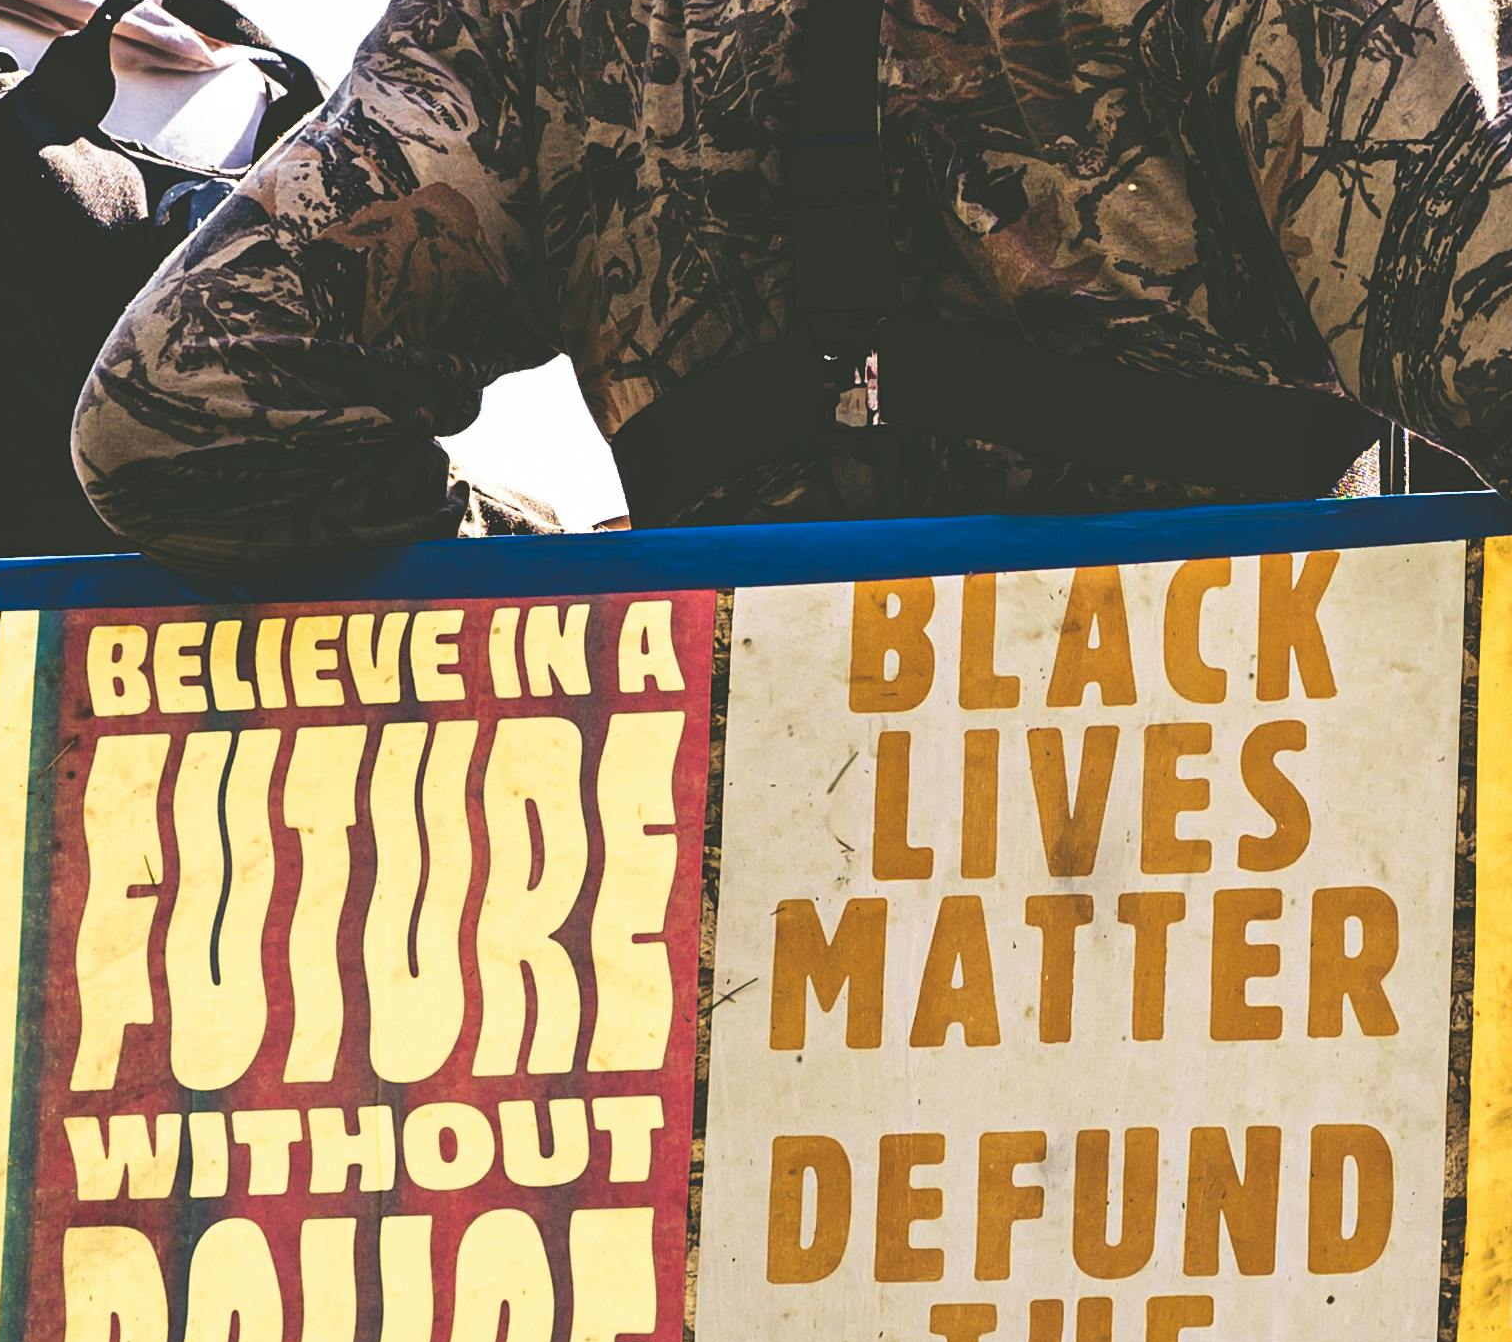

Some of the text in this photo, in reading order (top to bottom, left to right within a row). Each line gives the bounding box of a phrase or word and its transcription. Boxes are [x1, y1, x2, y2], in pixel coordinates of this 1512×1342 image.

[87, 600, 685, 716] BELIEVE IN A
[845, 550, 1342, 715] BLACK
[872, 719, 1312, 882] LIVES
[70, 711, 685, 1091] FUTURE
[768, 885, 1400, 1053] MATTER
[64, 1096, 664, 1200] WITHOUT
[766, 1123, 1396, 1285] DEFUND
